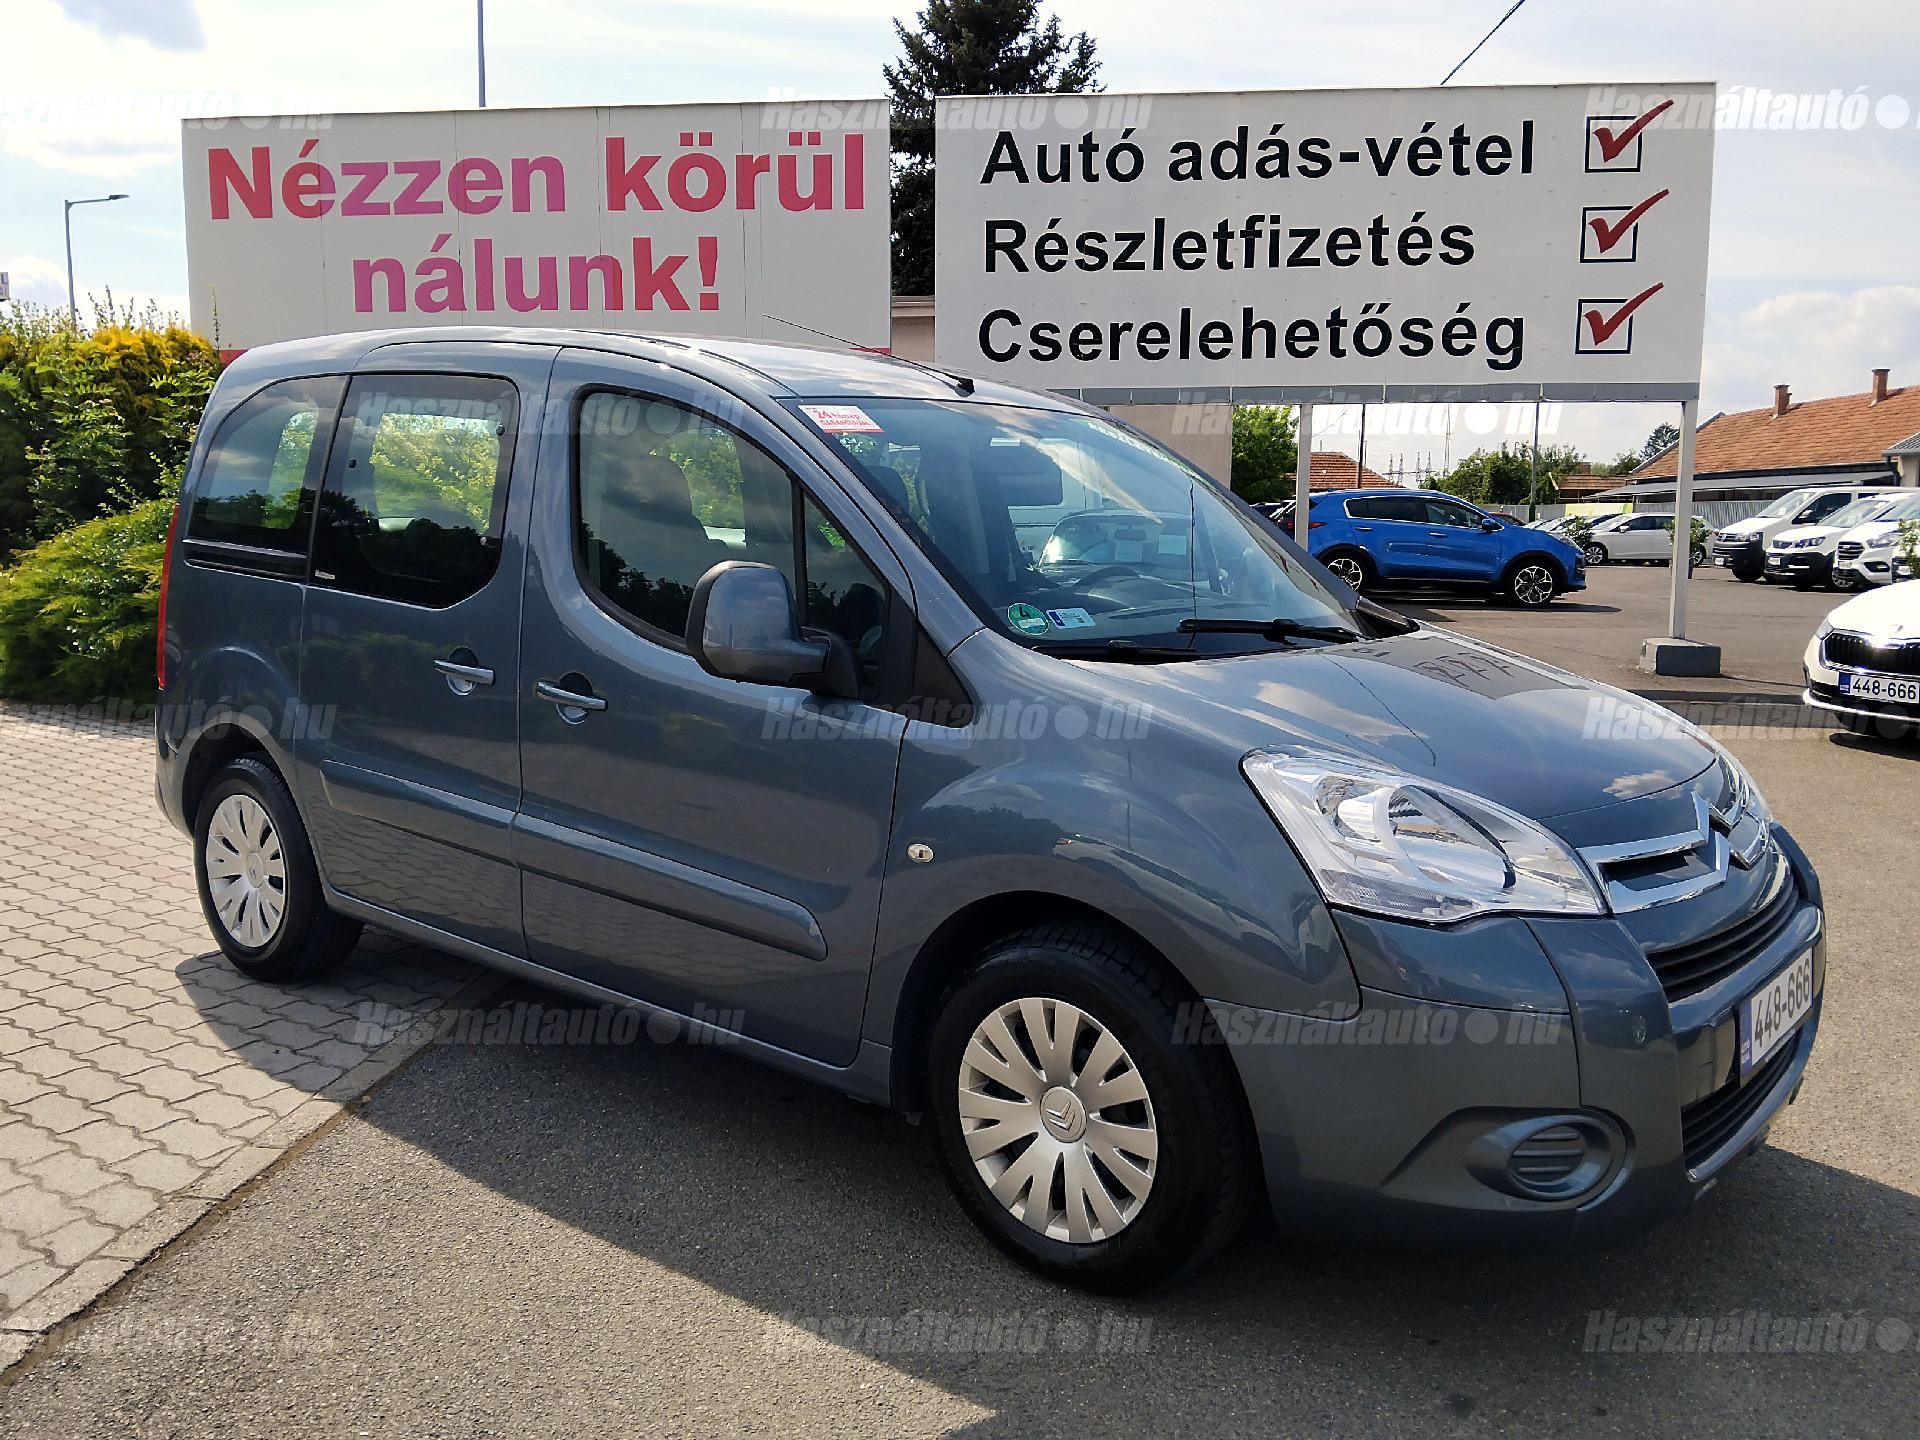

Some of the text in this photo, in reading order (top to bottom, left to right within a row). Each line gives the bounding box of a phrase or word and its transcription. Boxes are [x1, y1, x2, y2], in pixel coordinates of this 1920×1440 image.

[208, 131, 864, 220] Nézzen körül
[980, 120, 1533, 184] Autó adás-vétel
[353, 234, 719, 313] nálunk!
[986, 211, 1474, 273] Részletfizetés
[979, 303, 1523, 370] Cserelehetőség
[1853, 678, 1917, 700] 448-666
[1754, 958, 1810, 1048] 448-666
